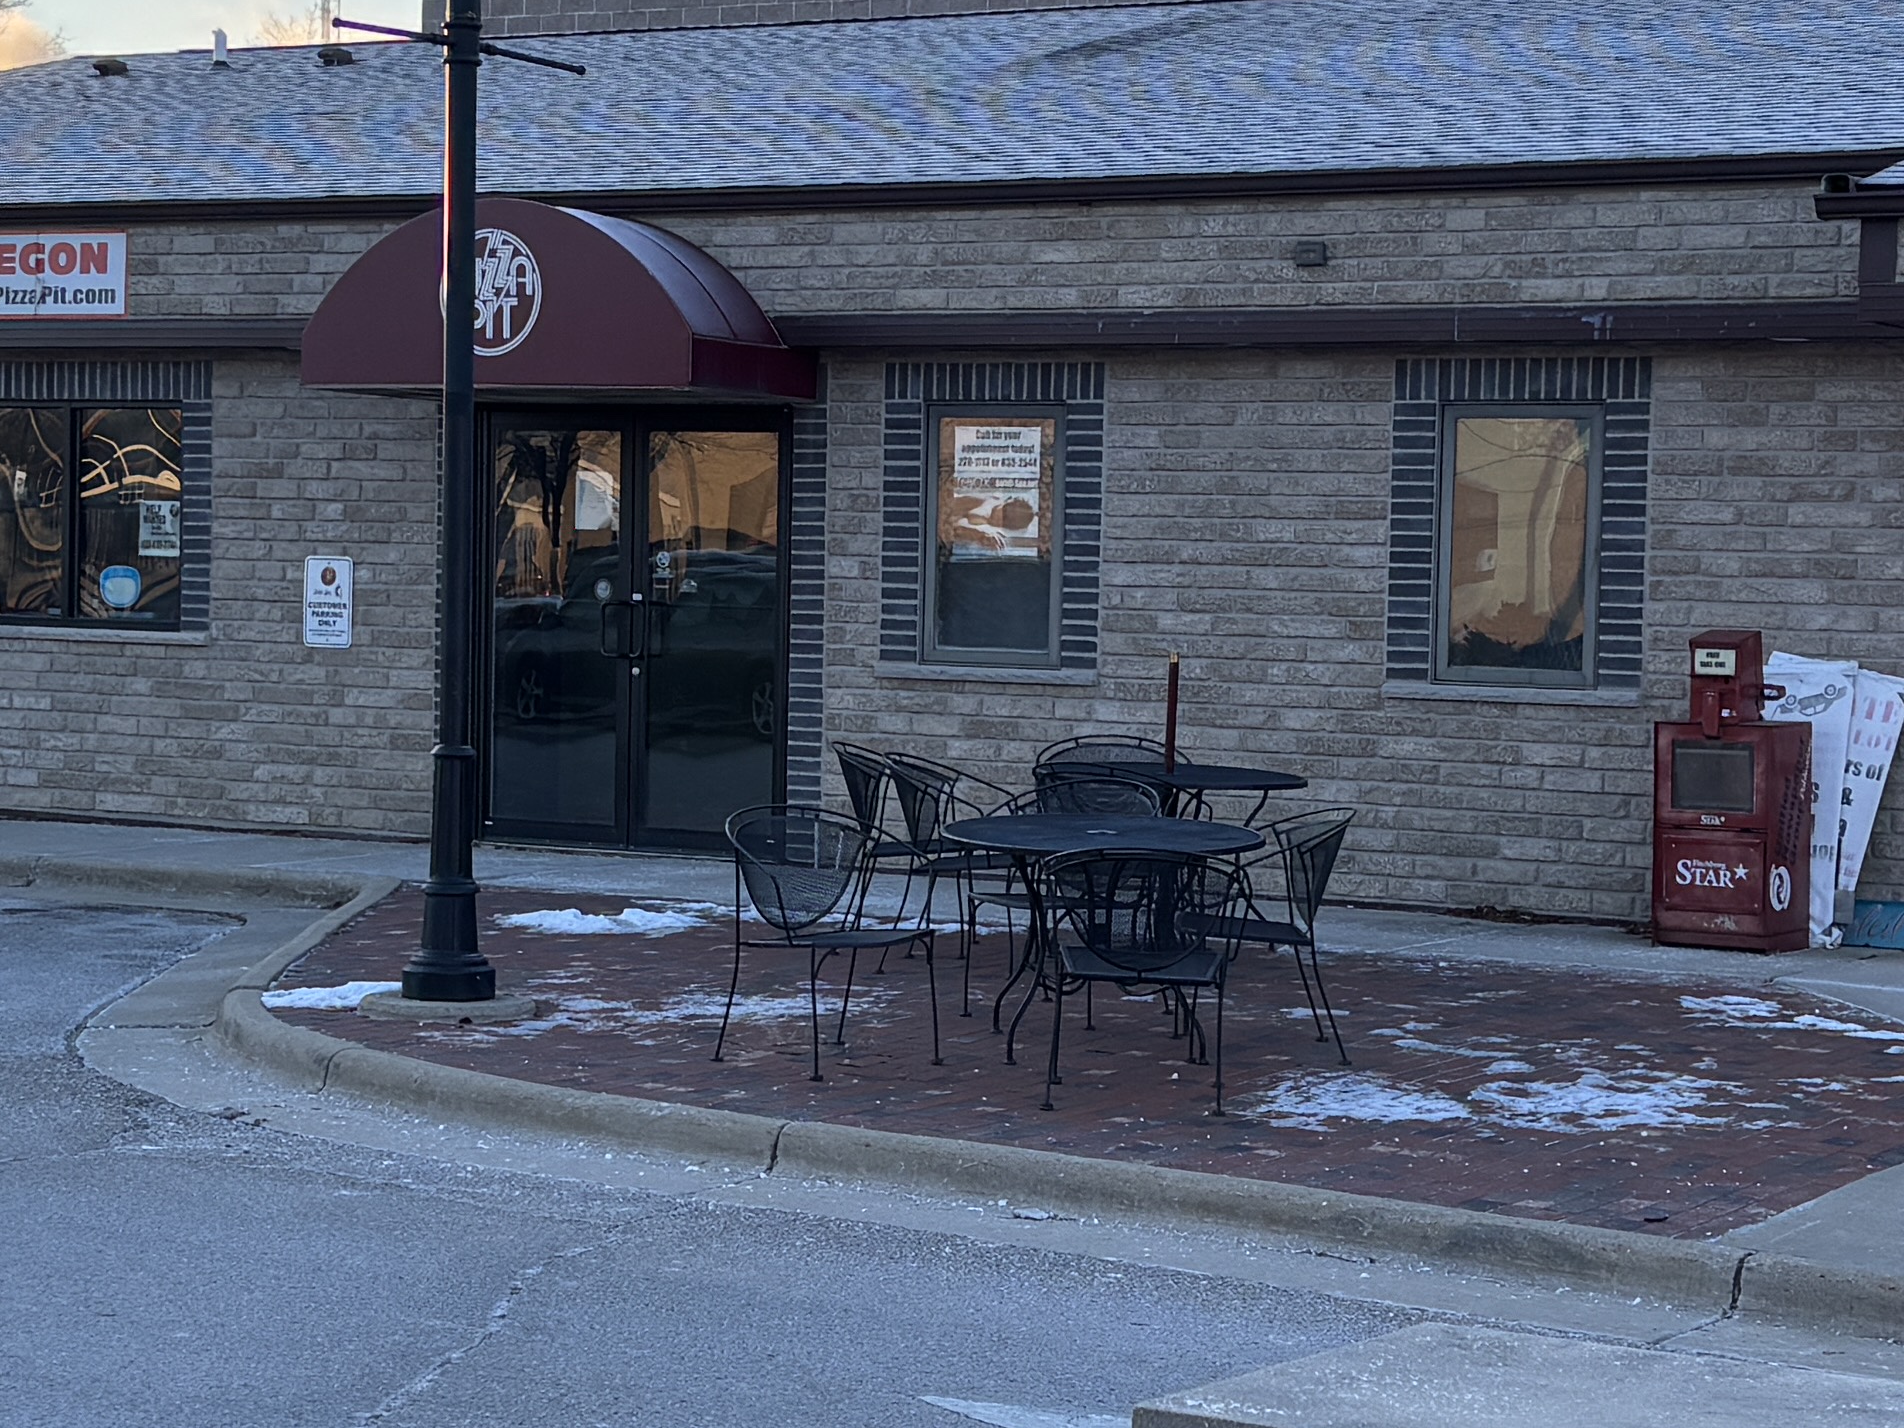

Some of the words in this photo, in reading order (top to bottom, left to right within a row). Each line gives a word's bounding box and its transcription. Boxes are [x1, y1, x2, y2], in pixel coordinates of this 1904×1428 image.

[307, 601, 348, 610] CUSTOMER
[311, 610, 344, 618] PARKING
[1676, 859, 1735, 888] STAR
